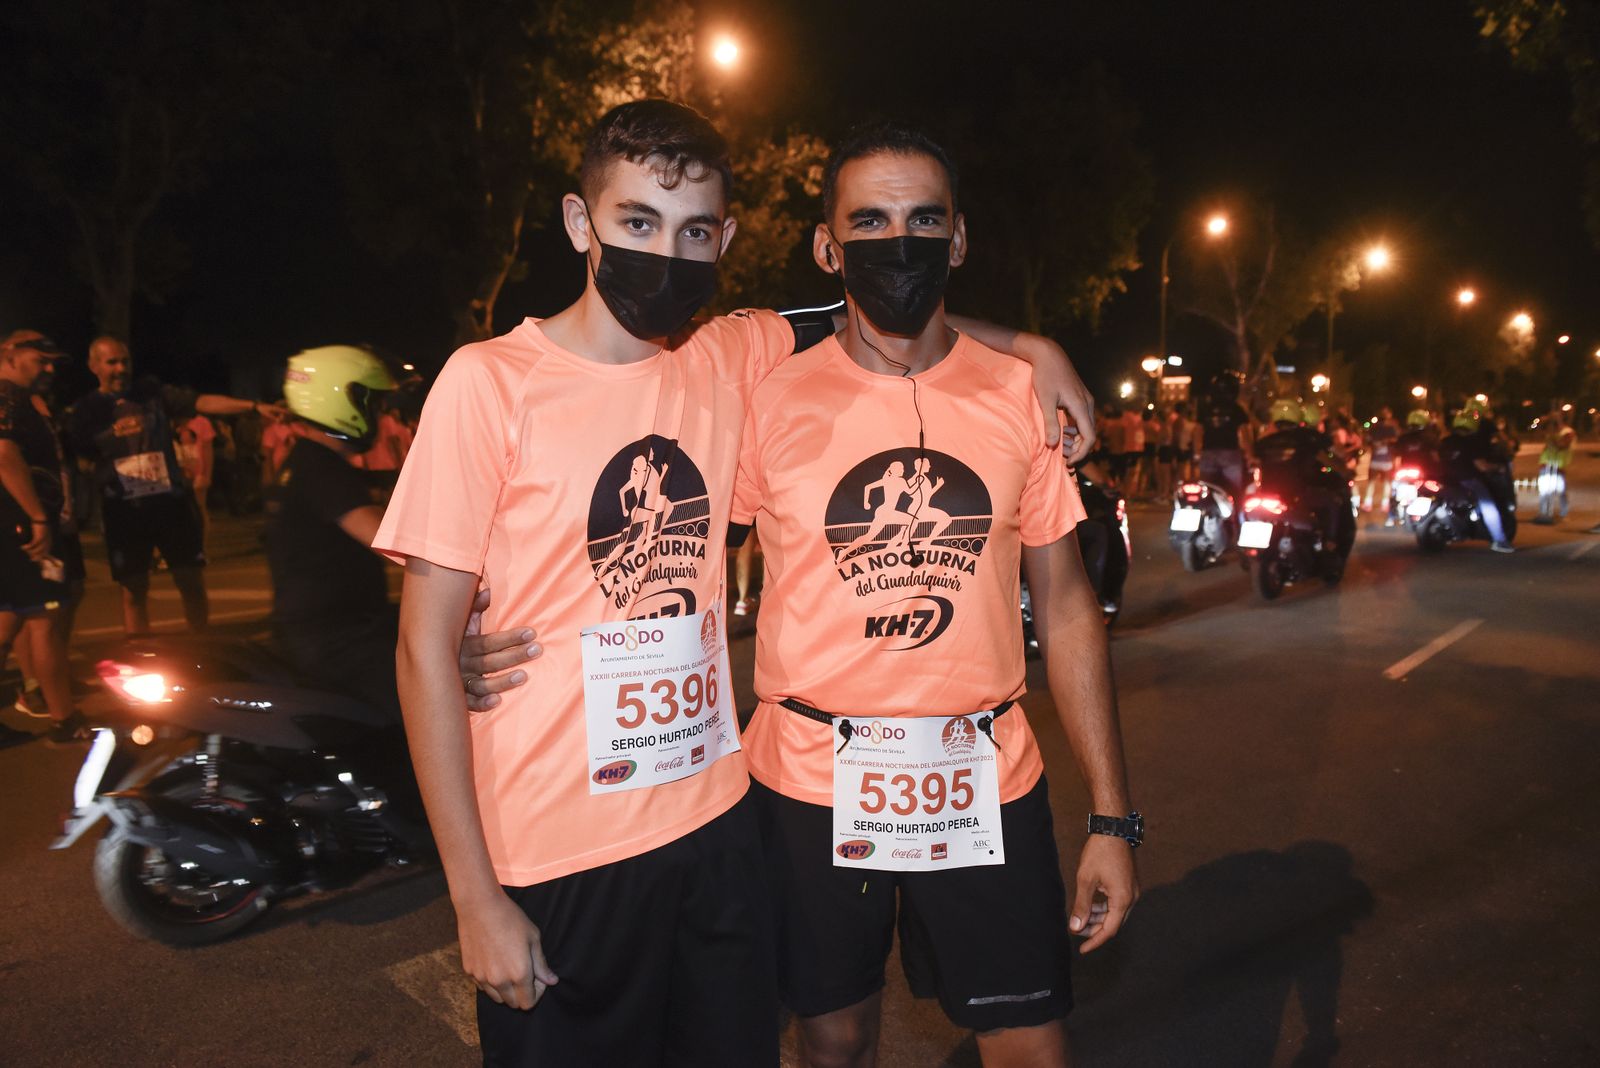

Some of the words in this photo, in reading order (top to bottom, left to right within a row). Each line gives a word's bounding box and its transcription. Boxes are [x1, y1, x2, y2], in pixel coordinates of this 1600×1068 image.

[838, 562, 865, 581] LA
[855, 580, 876, 597] del
[876, 570, 962, 592] Guadalquivir
[614, 586, 631, 609] del
[590, 671, 610, 681] XXXIII
[611, 670, 642, 679] CARRERA
[643, 665, 679, 677] NOCTURNA
[616, 663, 718, 730] 5396
[611, 734, 656, 751] SERGIO
[659, 722, 704, 743] HURTADO
[704, 710, 720, 731] PERE
[857, 760, 885, 768] CARRERA
[932, 757, 969, 768] GUADALQUIVIR
[980, 754, 993, 762] 2021
[859, 768, 974, 816] 5395
[853, 820, 894, 834] SERGIO
[896, 820, 946, 834] HURTADO
[948, 816, 980, 831] PEREA
[973, 839, 990, 847] ABC
